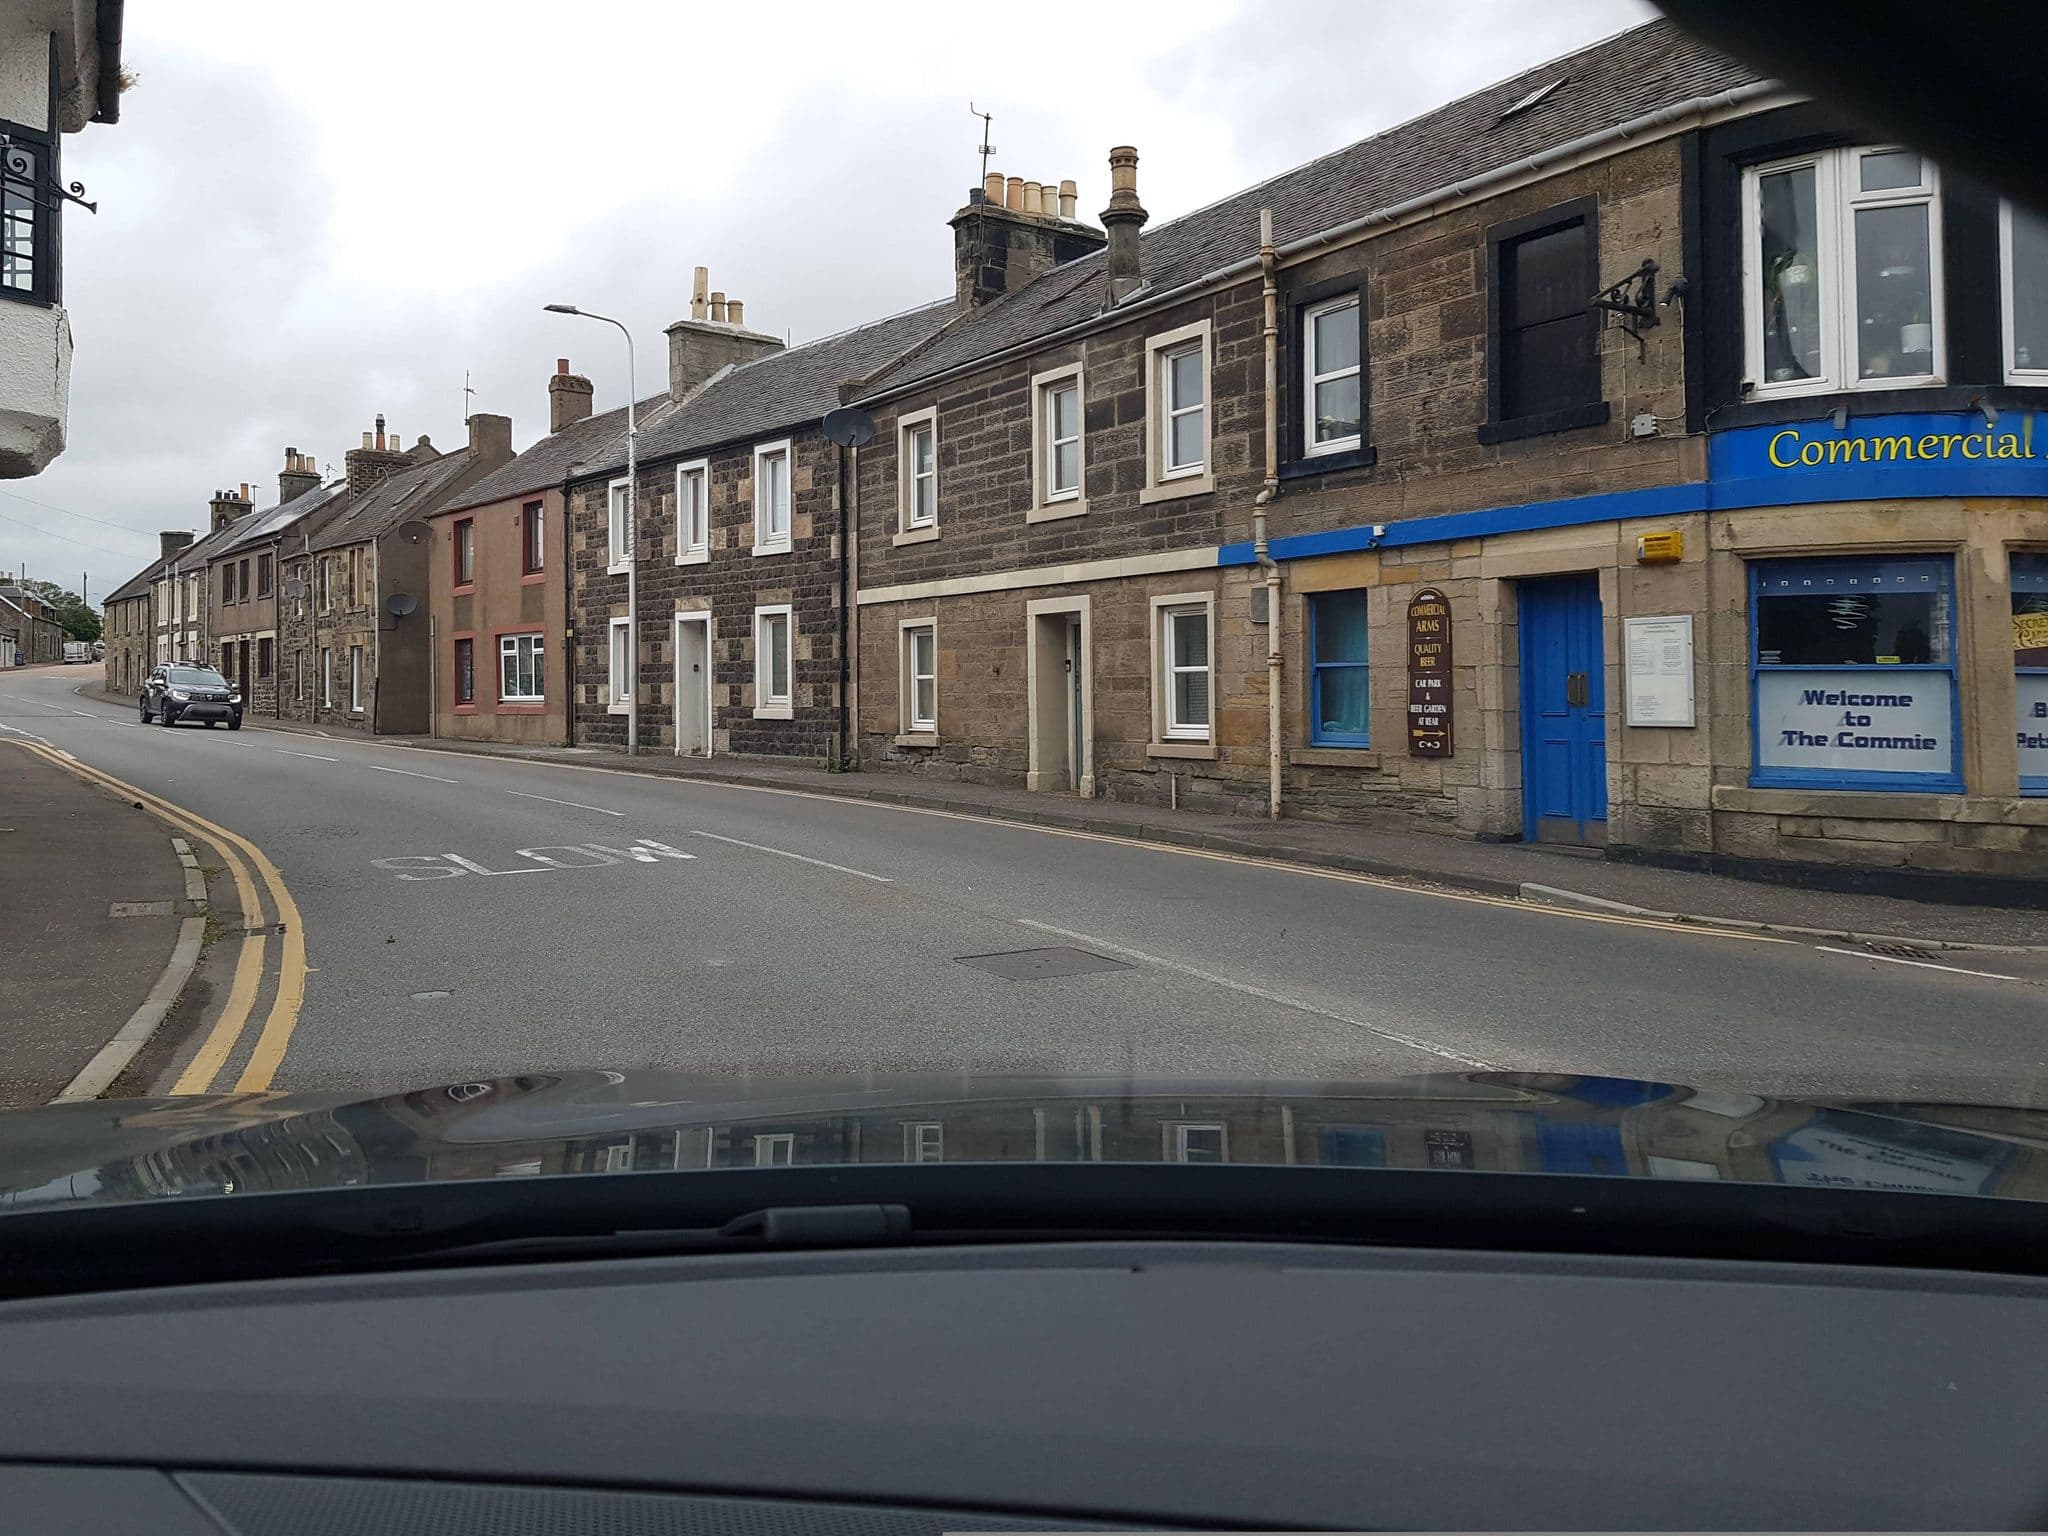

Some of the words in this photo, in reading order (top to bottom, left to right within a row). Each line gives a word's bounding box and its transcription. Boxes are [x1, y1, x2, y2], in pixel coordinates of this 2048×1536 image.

[1769, 421, 2036, 468] Commercial
[1411, 603, 1446, 616] COMMERCIAL
[1416, 619, 1440, 632] ARMS
[1414, 643, 1441, 656] QUALITY
[1420, 656, 1436, 667] BEER
[1415, 679, 1426, 688] CAR
[1427, 679, 1442, 688] PARK
[1425, 691, 1431, 701] &
[1802, 690, 1914, 707] Welcome
[1410, 704, 1422, 713] BEER
[1423, 704, 1447, 713] GARDEN
[1417, 716, 1425, 726] AT
[1425, 717, 1440, 726] REAR
[1844, 710, 1872, 728] to
[1782, 730, 1829, 747] The
[1837, 731, 1938, 750] Commie
[369, 838, 698, 881] SLOW
